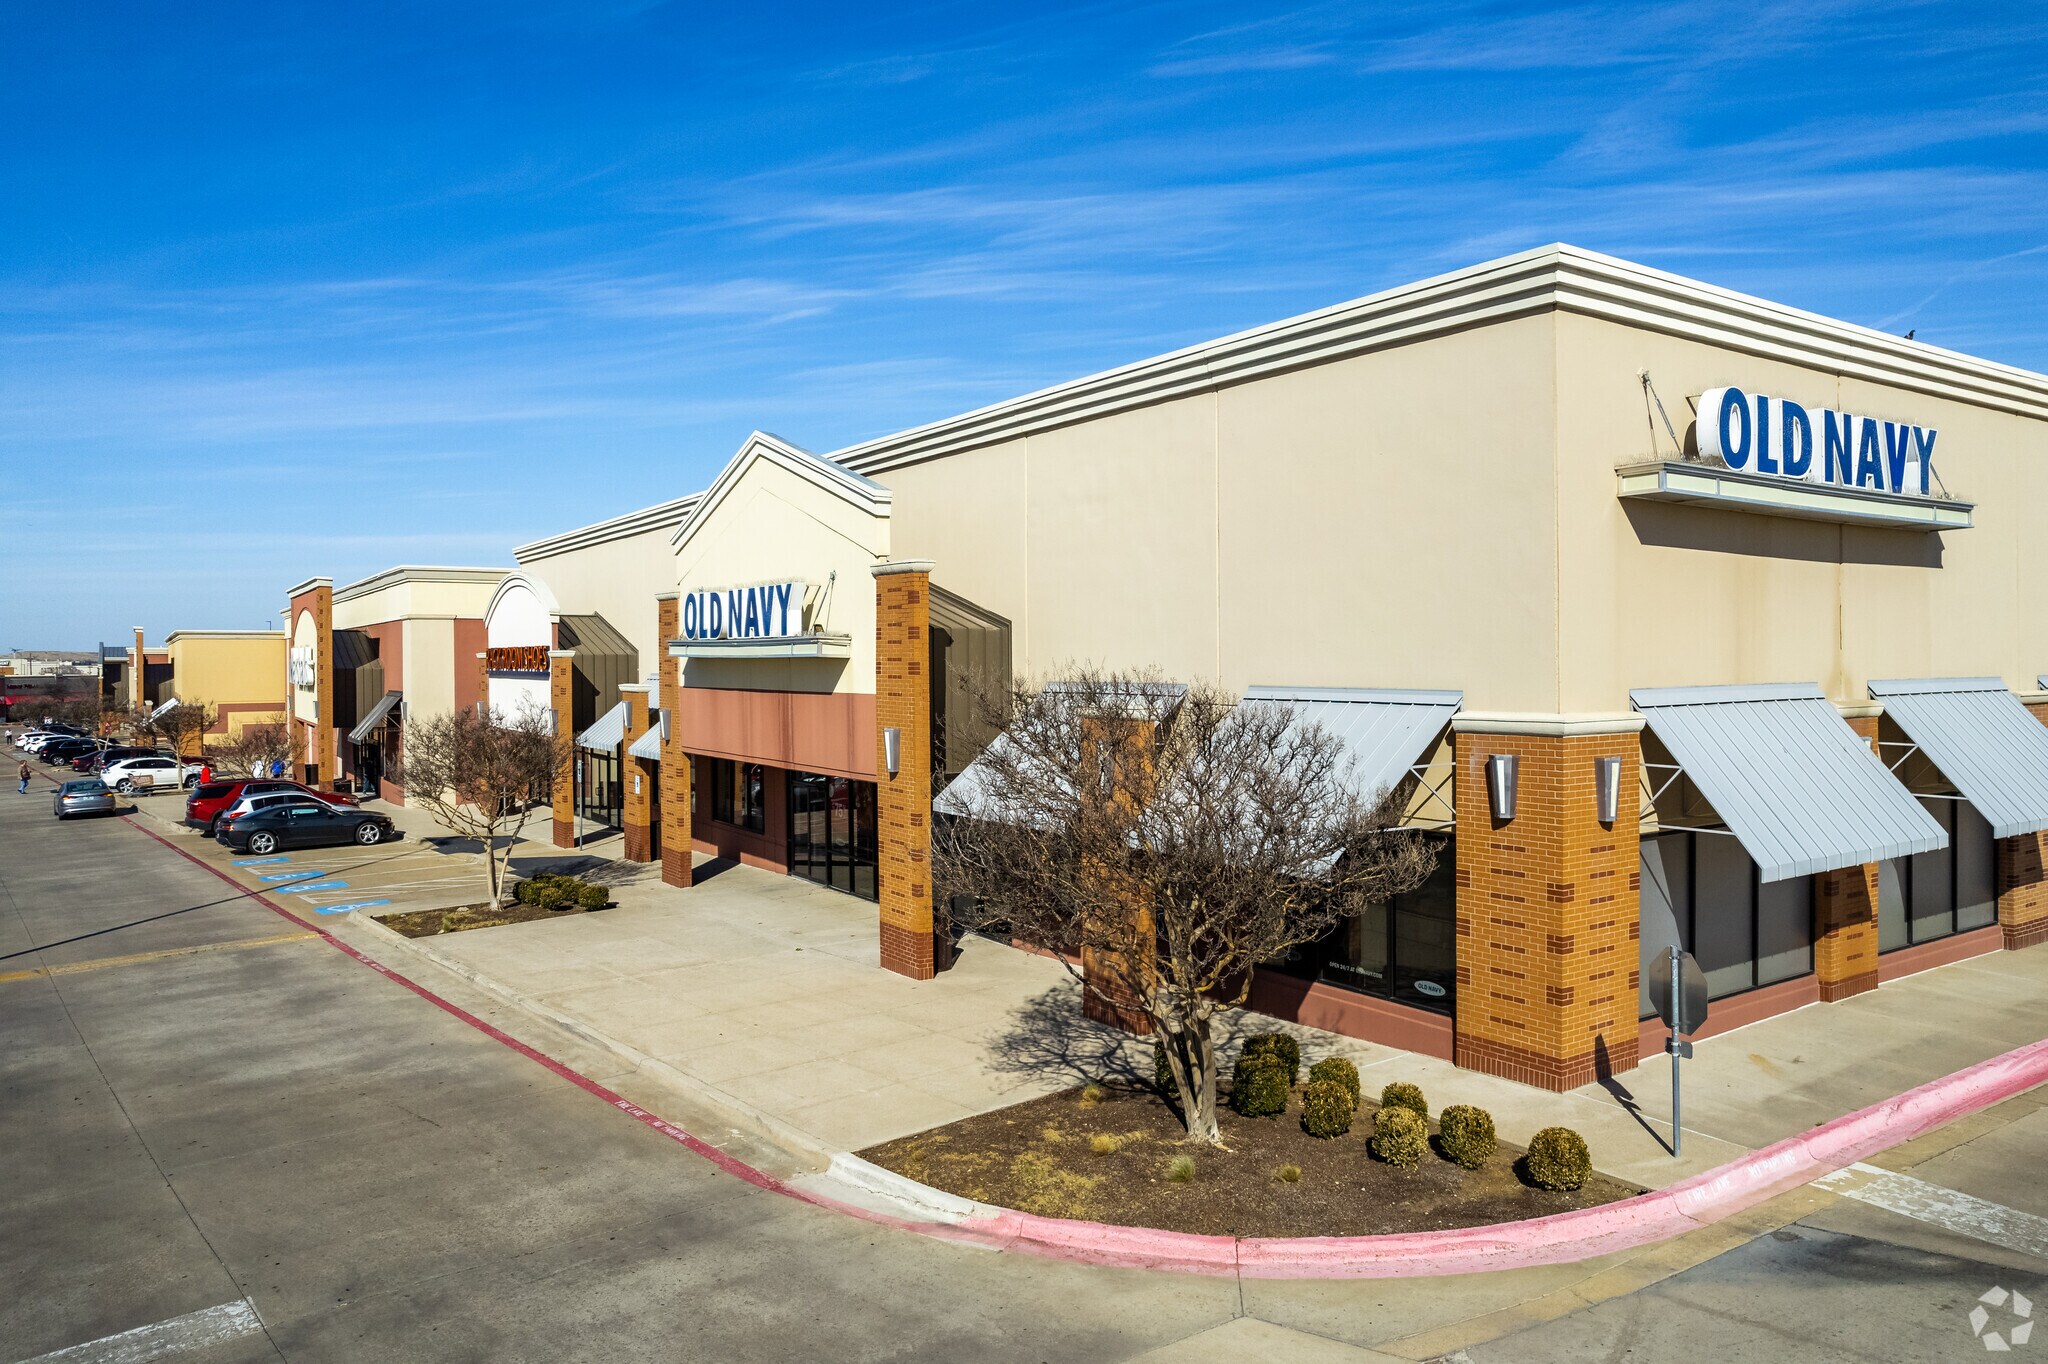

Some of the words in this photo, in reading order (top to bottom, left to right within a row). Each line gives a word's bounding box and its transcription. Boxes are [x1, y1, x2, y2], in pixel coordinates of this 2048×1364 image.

[1718, 386, 1813, 479] OLD
[1823, 408, 1938, 496] NAVY
[684, 592, 722, 640] OLD
[727, 582, 793, 639] NAVY
[523, 645, 548, 670] SHOES
[1329, 961, 1340, 969] OPEN
[1355, 967, 1383, 979] OAVY.COM
[1428, 985, 1442, 993] NAVY
[1686, 1185, 1706, 1205] FIRE
[1708, 1175, 1730, 1195] LANE
